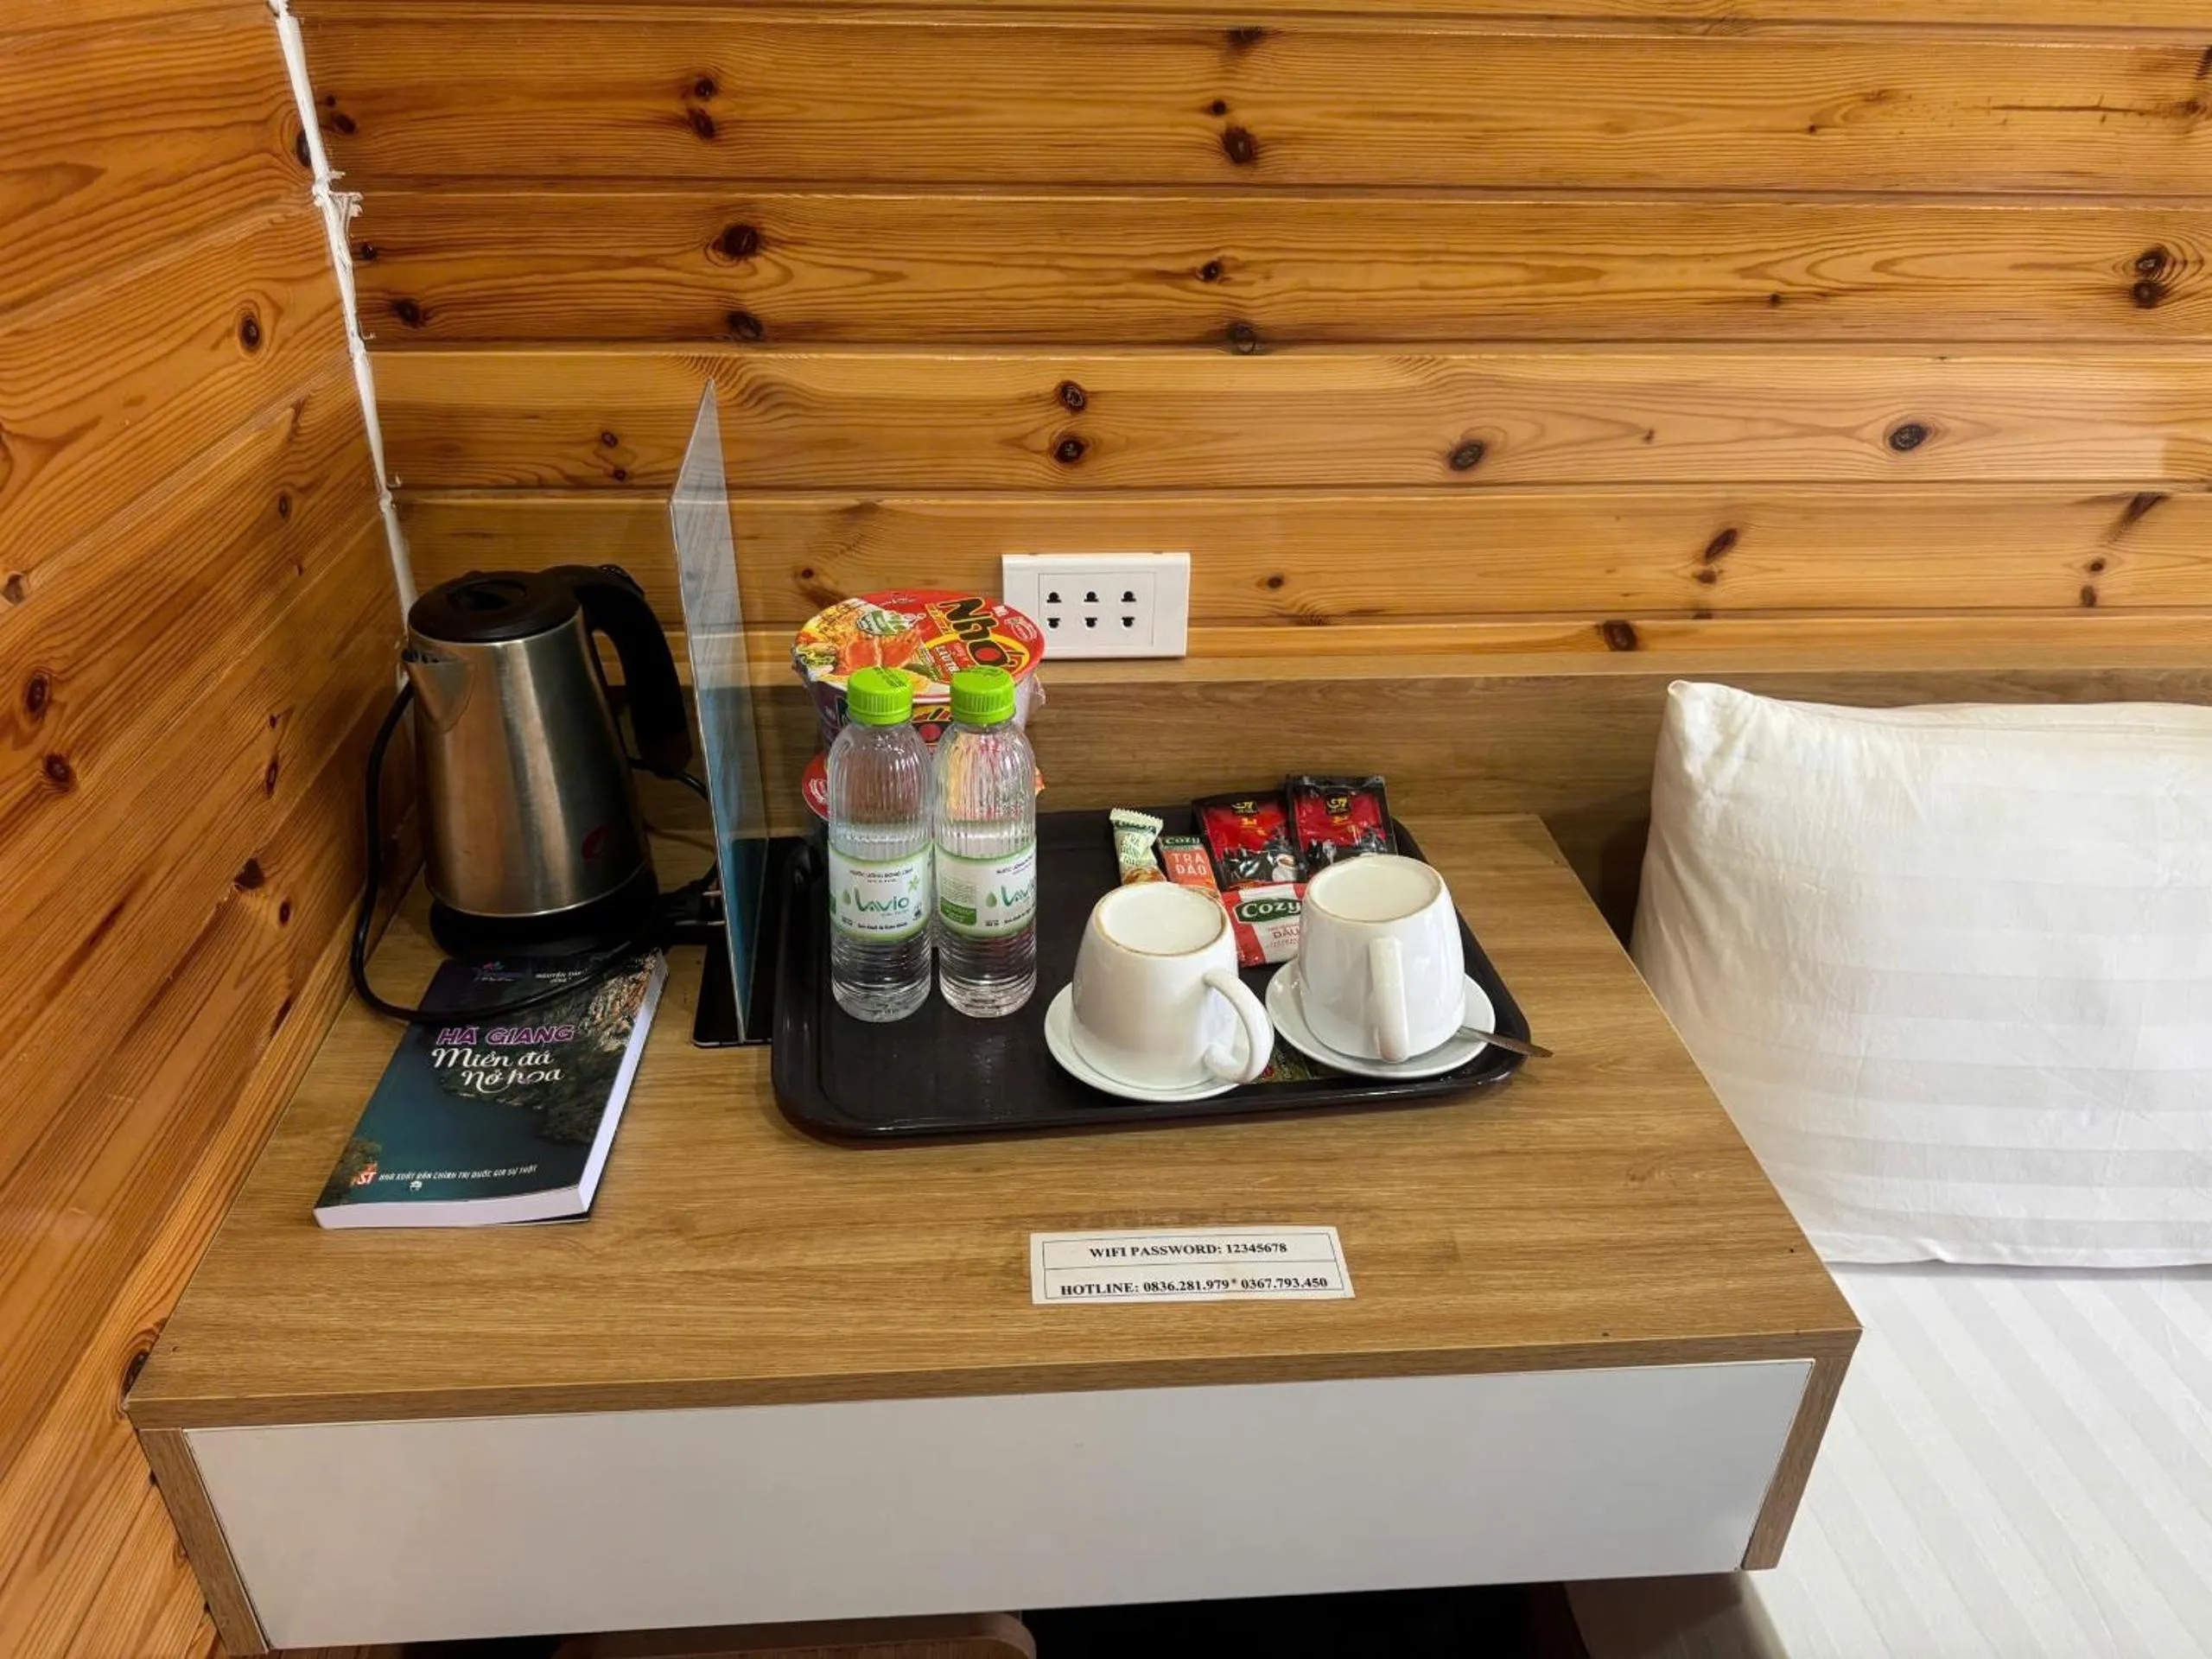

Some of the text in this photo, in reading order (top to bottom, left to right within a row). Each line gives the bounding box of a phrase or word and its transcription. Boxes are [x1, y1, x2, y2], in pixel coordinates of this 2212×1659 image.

[485, 1024, 576, 1046] GIANG
[518, 1049, 556, 1067] đá
[1090, 1243, 1287, 1258] WIFI PASSWORD: 12345678
[1061, 1282, 1140, 1295] HOTLINE:
[1241, 1277, 1328, 1290] 0367.793.450
